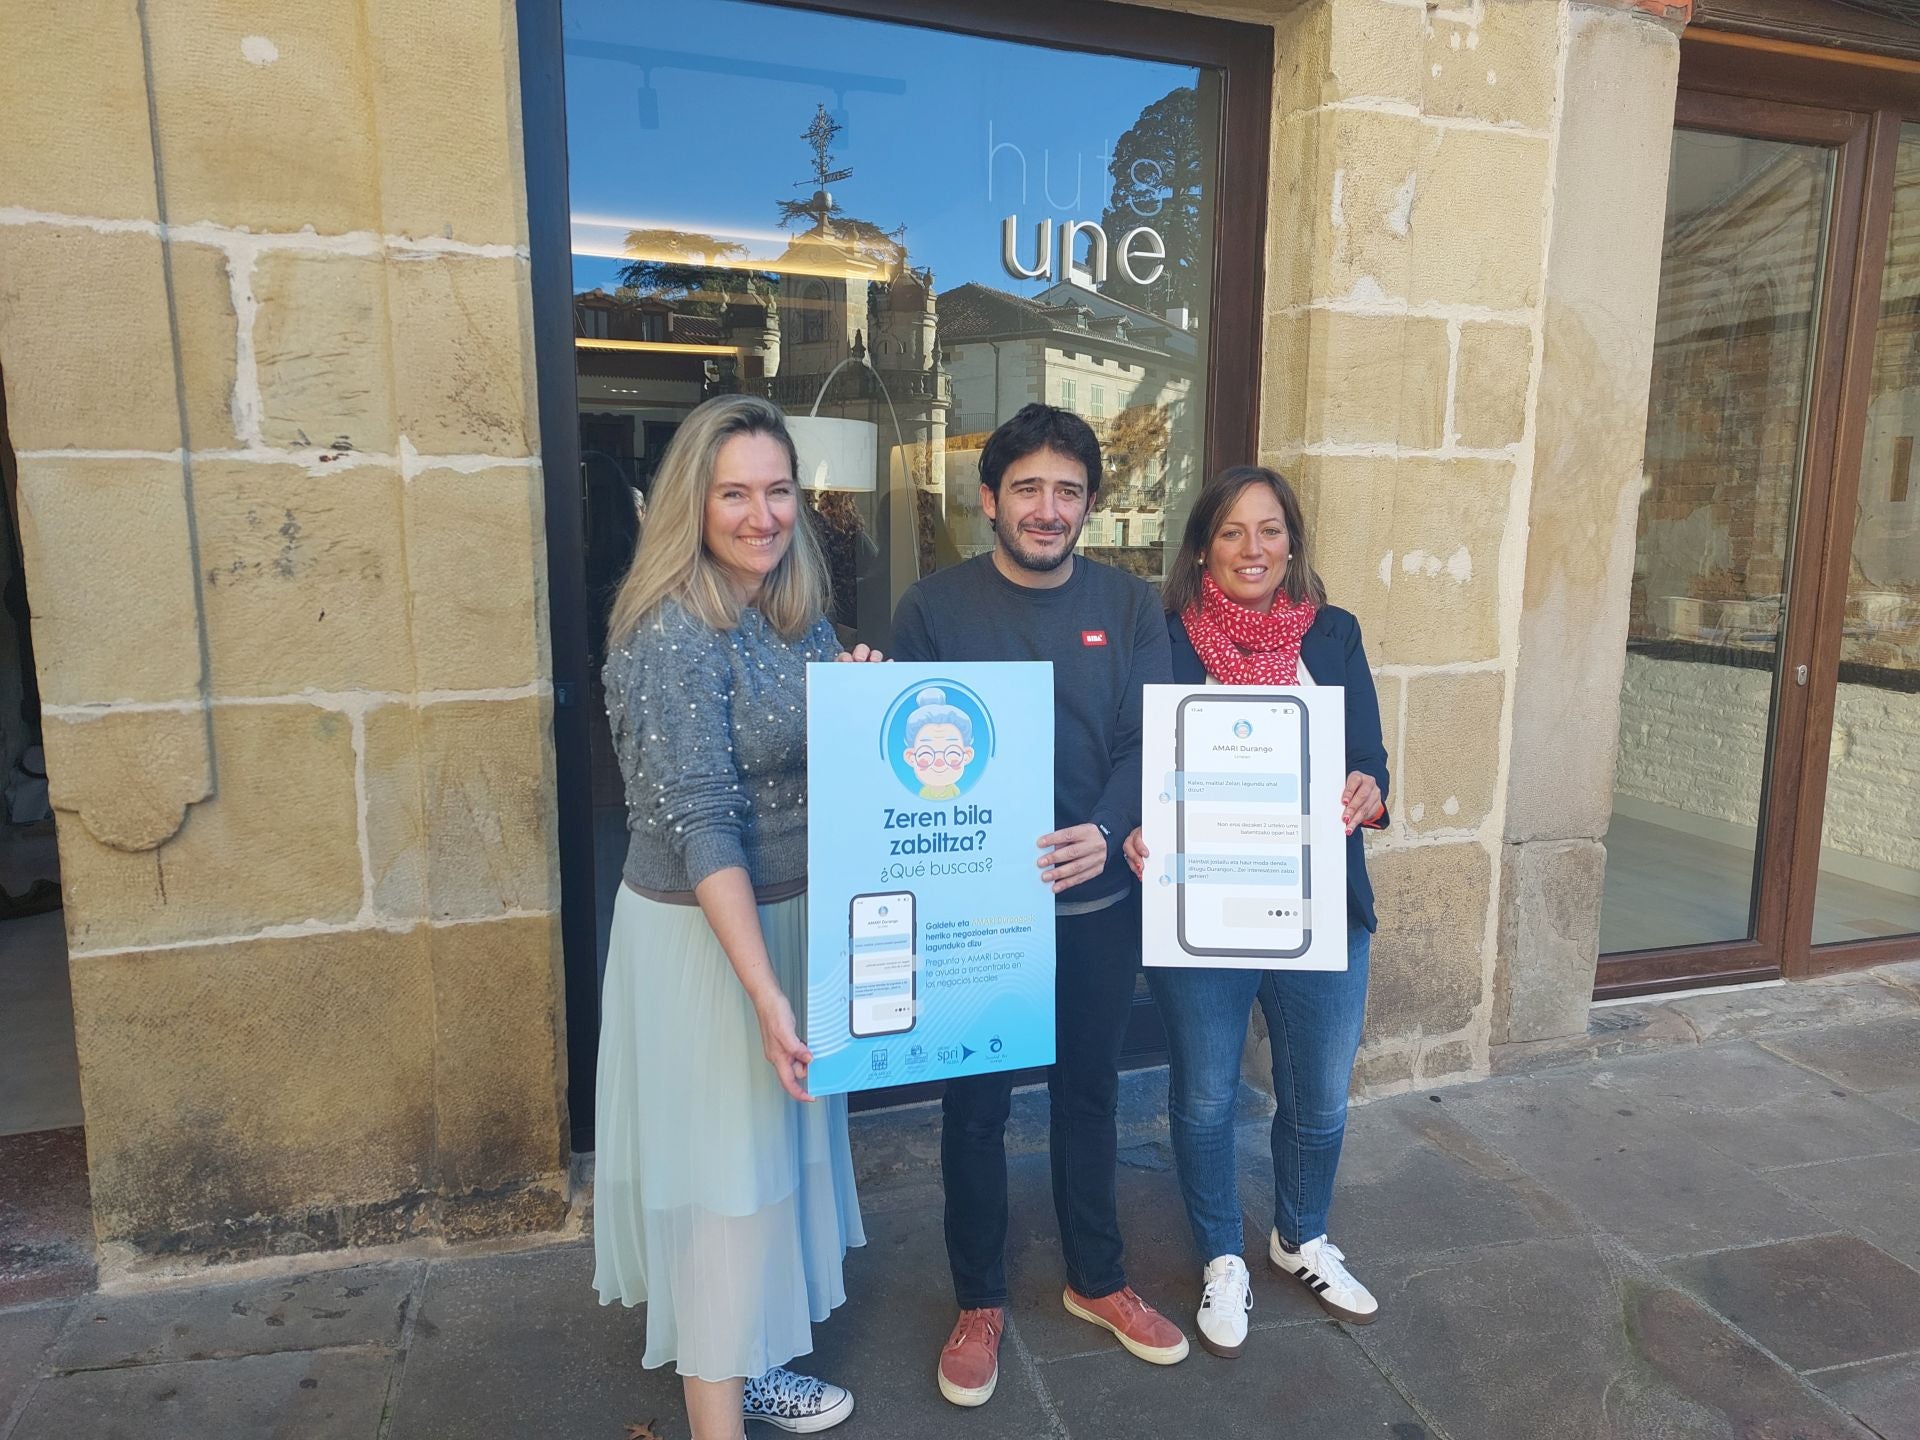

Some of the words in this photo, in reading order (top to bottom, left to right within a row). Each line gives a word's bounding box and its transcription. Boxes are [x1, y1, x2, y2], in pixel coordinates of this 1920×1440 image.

[1001, 214, 1165, 286] une
[1240, 745, 1273, 753] Durango
[883, 807, 947, 829] Zeren
[953, 804, 993, 826] bila
[889, 830, 987, 856] zabiltza?
[880, 860, 926, 883] ¿Qué
[930, 857, 993, 876] buscas?
[925, 921, 956, 931] Galdetu
[957, 920, 970, 928] eta
[925, 931, 951, 941] herriko
[952, 928, 998, 939] negozioetan
[999, 925, 1032, 935] aurkitzen
[925, 940, 966, 953] lagunduko
[967, 939, 982, 948] dizu
[925, 957, 960, 968] Pregunta
[967, 953, 992, 962] AMARI
[993, 951, 1025, 961] Durango
[925, 969, 933, 978] te
[935, 967, 960, 977] ayuda
[968, 961, 1010, 973] encontrarlo
[1011, 961, 1022, 969] en
[925, 980, 935, 988] los
[936, 977, 971, 988] negocios
[972, 974, 998, 983] locales
[937, 1046, 958, 1064] spri
